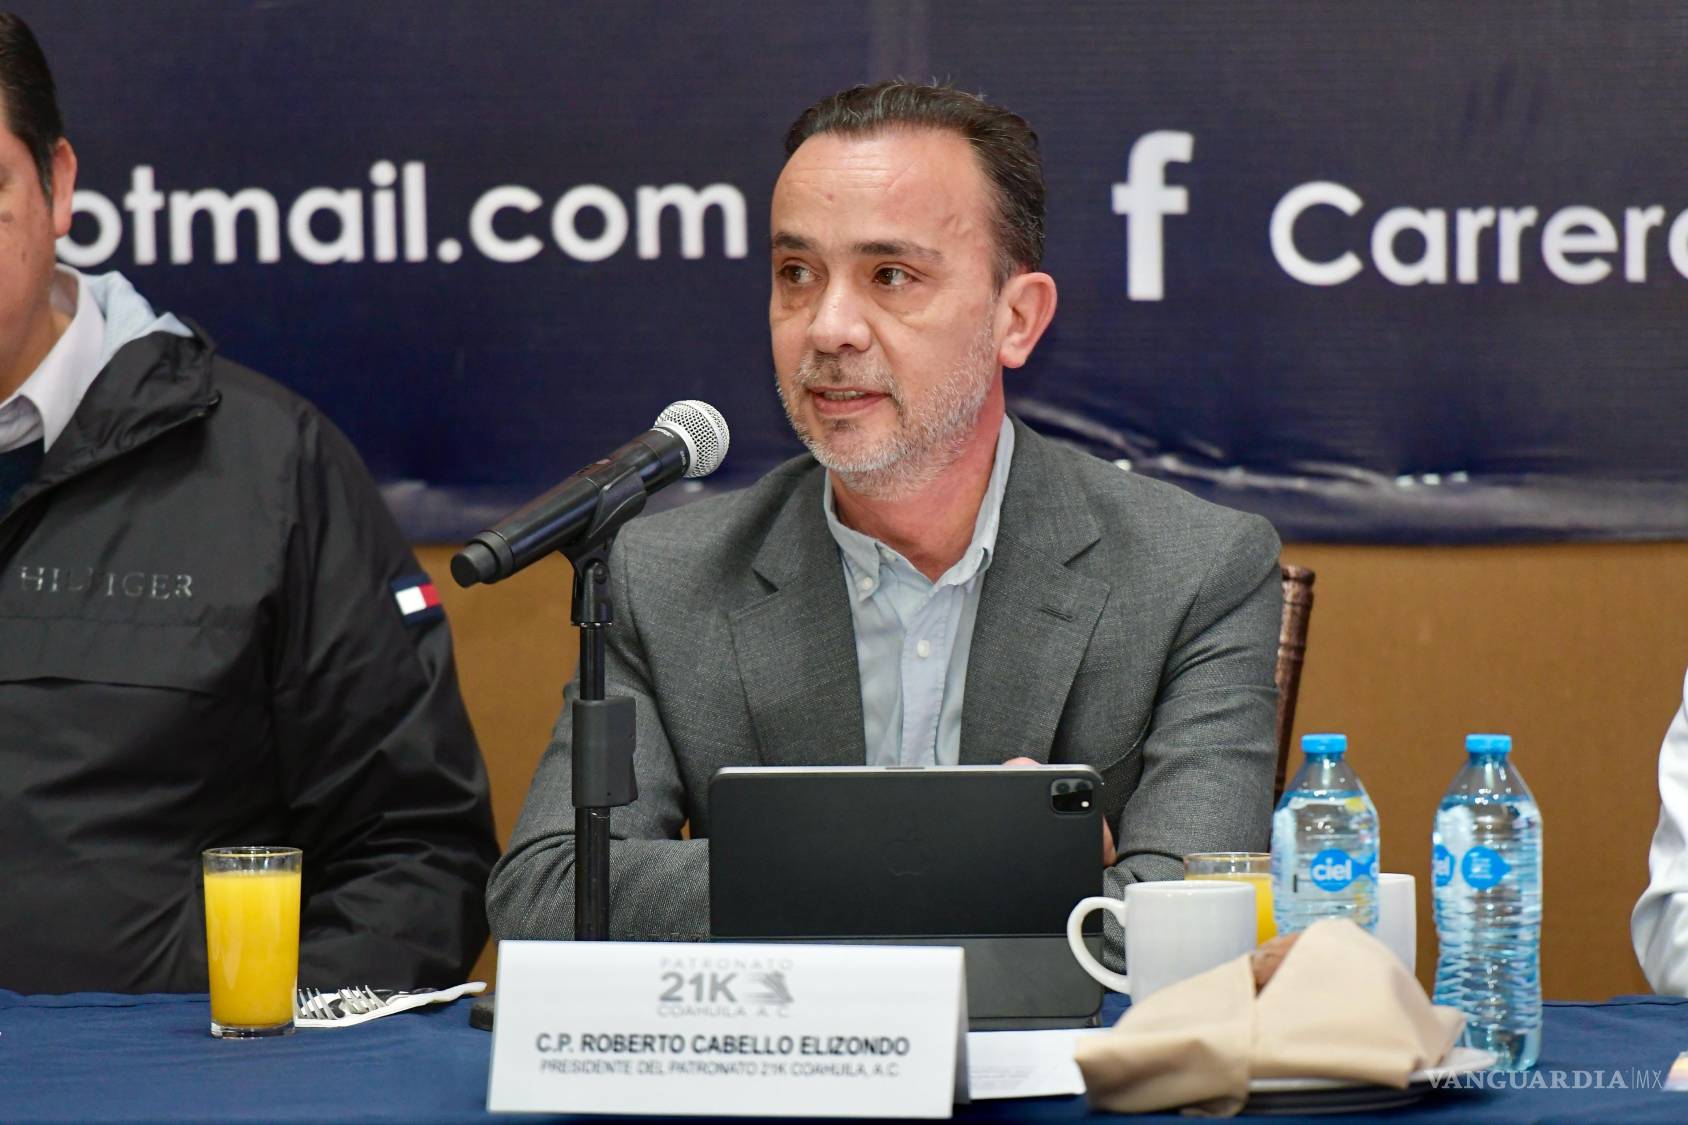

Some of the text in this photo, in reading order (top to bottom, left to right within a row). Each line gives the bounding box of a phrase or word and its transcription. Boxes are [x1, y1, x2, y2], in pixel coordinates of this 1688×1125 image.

[1269, 180, 1688, 286] Carrer
[1312, 857, 1352, 881] ciel
[658, 971, 737, 1003] 21K
[536, 1033, 911, 1056] C.P. ROBERTO CABELLO ELIZONDO
[540, 1058, 632, 1074] PRESIDENTE
[638, 1060, 664, 1075] DEL
[669, 1060, 757, 1076] PATRONATO
